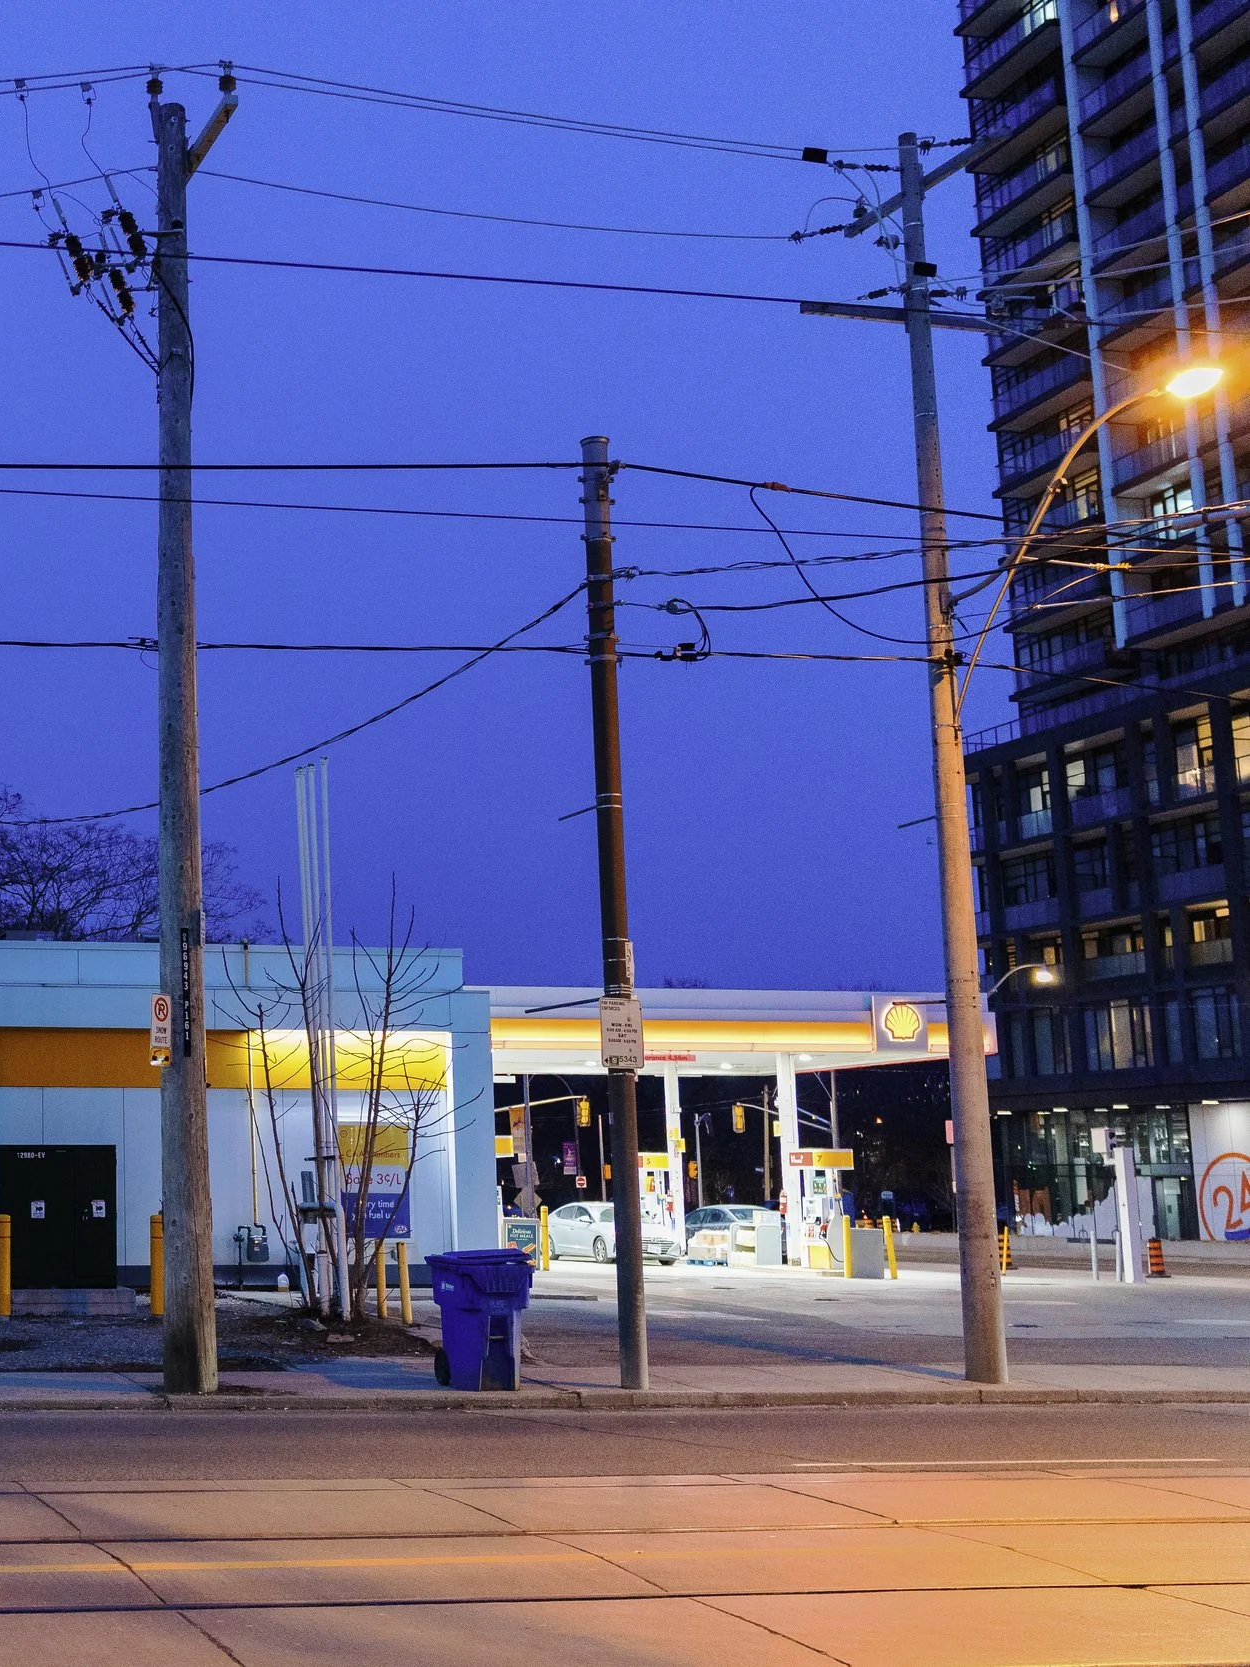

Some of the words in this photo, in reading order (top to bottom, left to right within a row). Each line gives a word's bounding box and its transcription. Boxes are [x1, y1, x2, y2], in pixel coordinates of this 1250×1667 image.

[346, 1173, 373, 1184] Sae
[378, 1200, 394, 1208] time
[369, 1210, 383, 1219] fuel
